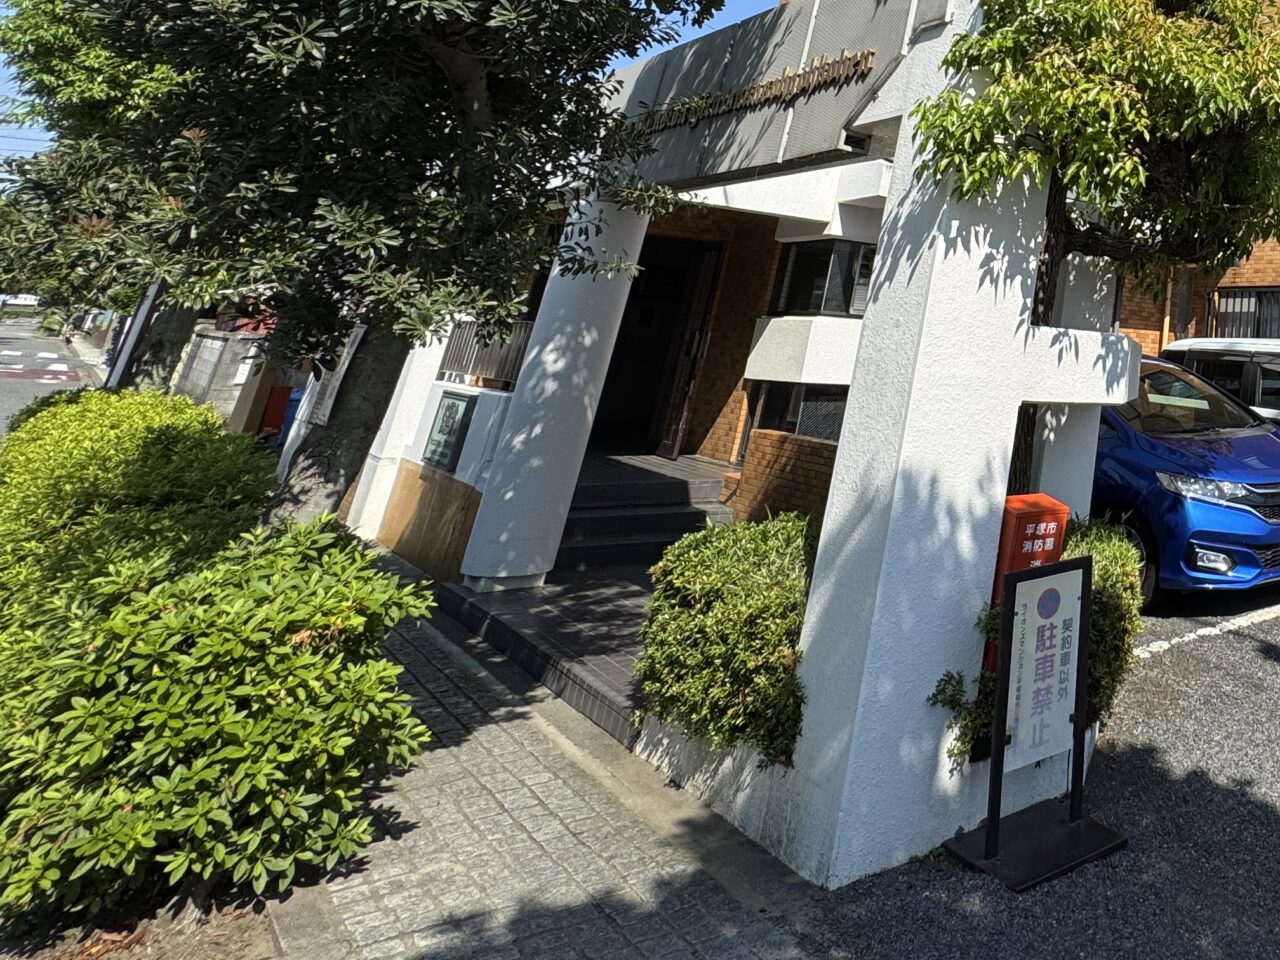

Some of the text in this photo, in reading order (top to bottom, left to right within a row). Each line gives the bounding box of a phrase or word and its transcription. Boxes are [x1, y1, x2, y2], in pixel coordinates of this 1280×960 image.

[1021, 538, 1055, 554] 消防署
[1025, 522, 1058, 536] 平塚市
[1028, 621, 1058, 750] 駐車禁止
[1057, 617, 1074, 703] 契約車以外
